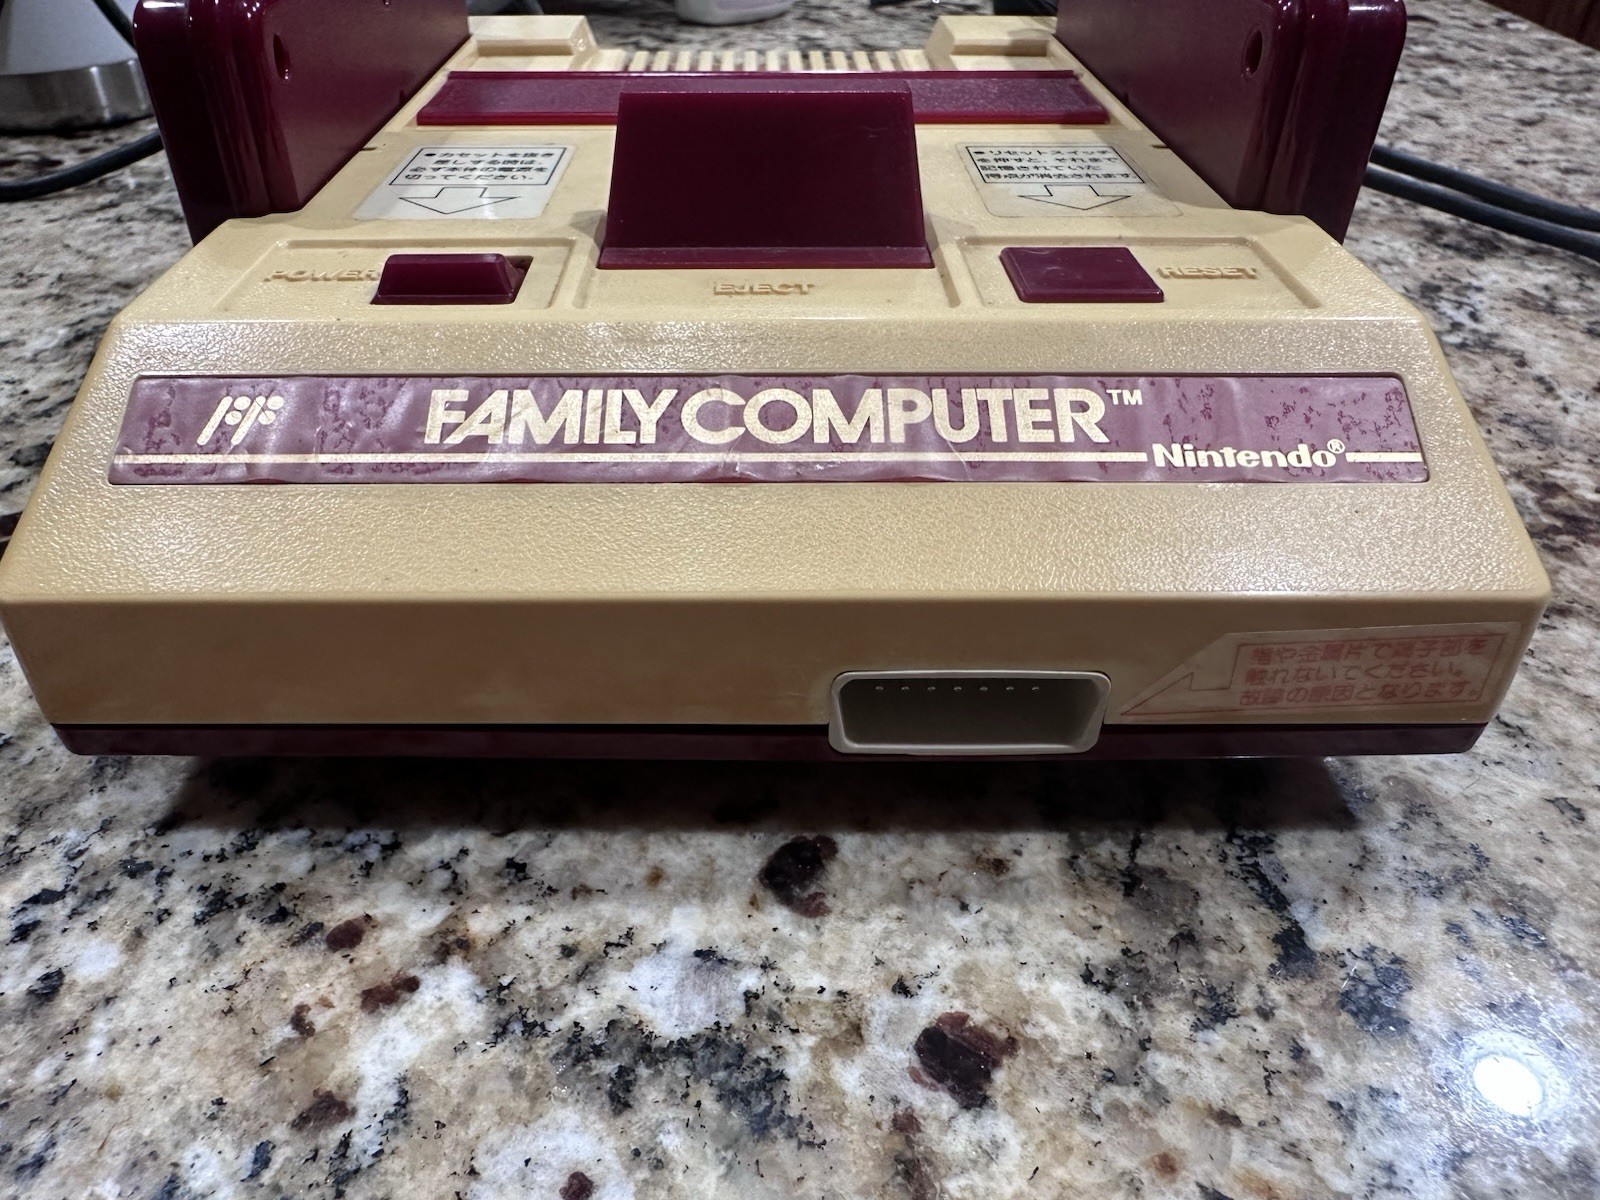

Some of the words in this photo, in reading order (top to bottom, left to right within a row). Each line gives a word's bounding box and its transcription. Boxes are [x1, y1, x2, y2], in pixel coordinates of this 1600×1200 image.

[1157, 265, 1258, 280] RESET
[713, 281, 815, 296] EJECT
[423, 388, 678, 447] FAMILY
